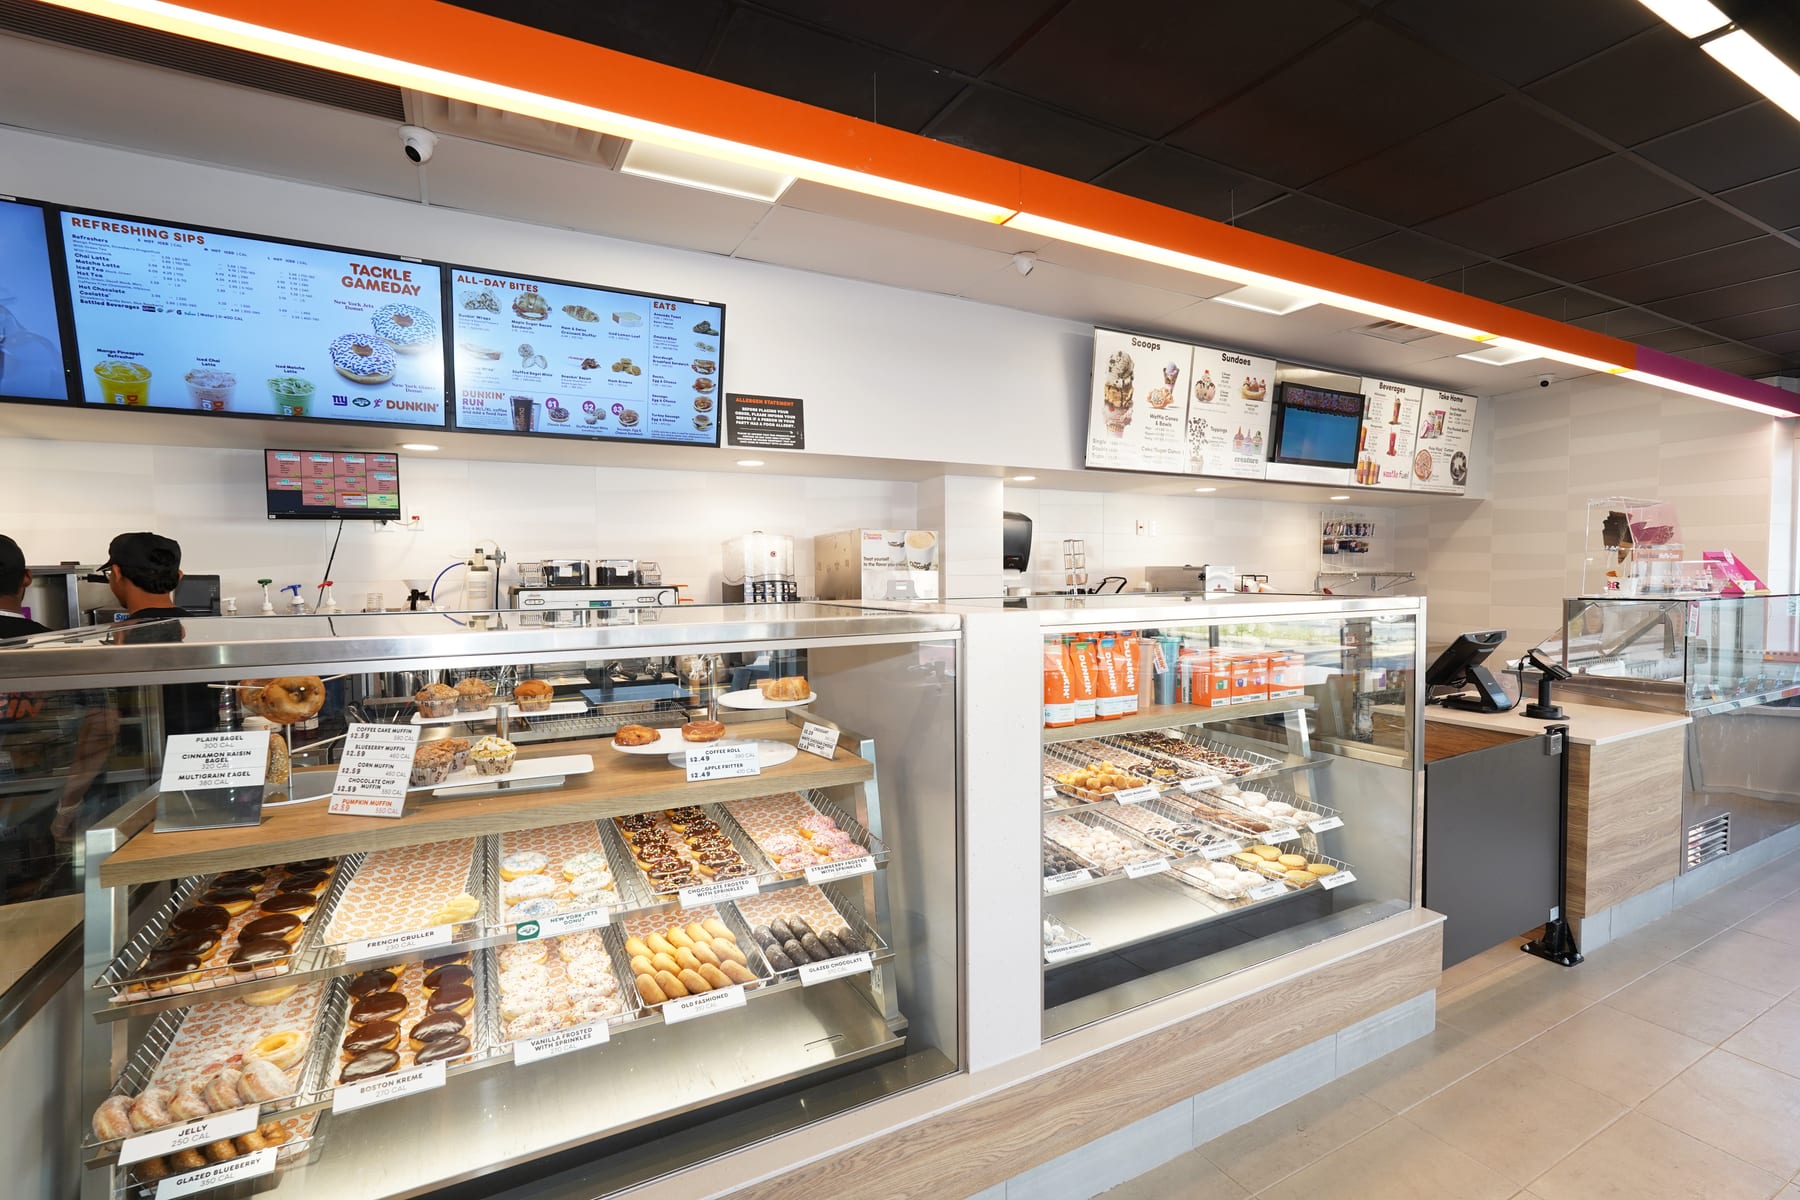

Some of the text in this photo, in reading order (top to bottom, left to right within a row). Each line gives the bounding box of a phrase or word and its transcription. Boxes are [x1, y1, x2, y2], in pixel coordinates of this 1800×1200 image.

[71, 217, 205, 245] REFRESHING SIPS
[350, 263, 412, 282] TACKLE
[341, 276, 421, 296] GAMEDAY
[457, 274, 539, 293] ALL-DAY BITES
[653, 301, 677, 311] EATS
[1131, 337, 1161, 351] Scoops
[1221, 353, 1251, 366] Sundaes
[1379, 382, 1406, 394] Beverages
[462, 390, 506, 400] DUNKIN'
[1439, 392, 1463, 402] Take Home
[386, 399, 439, 412] DUNKIN'
[462, 398, 484, 407] RUN
[584, 403, 594, 411] $2
[1123, 640, 1135, 691] DUNKIN'
[1078, 654, 1092, 695] DUNKIN'
[1104, 652, 1118, 693] DUNKIN'
[182, 752, 225, 760] CINNAMON
[331, 804, 350, 812] $2.59
[811, 862, 844, 872] STRAWBERRY
[836, 864, 862, 872] SPRINKLES
[688, 880, 749, 894] CHOCOLATE FROSTED
[713, 886, 744, 895] SPRINKLES
[563, 917, 585, 925] DONUT
[367, 931, 434, 948] FRENCH CRULLER
[809, 957, 862, 973] GLAZED CHOCOLATE
[695, 992, 729, 1005] FASHIONED
[531, 1027, 593, 1047] VANILLA FROSTED
[534, 1033, 592, 1051] WITH SPRINKLES
[360, 1072, 423, 1094] BOSTON KREME
[375, 1086, 407, 1098] 270 CAL
[177, 1124, 208, 1137] JELLY
[171, 1132, 210, 1147] 250 CAL
[176, 1158, 262, 1186] GLAZED BLUEBERRY
[199, 1173, 235, 1187] 350 CAL
